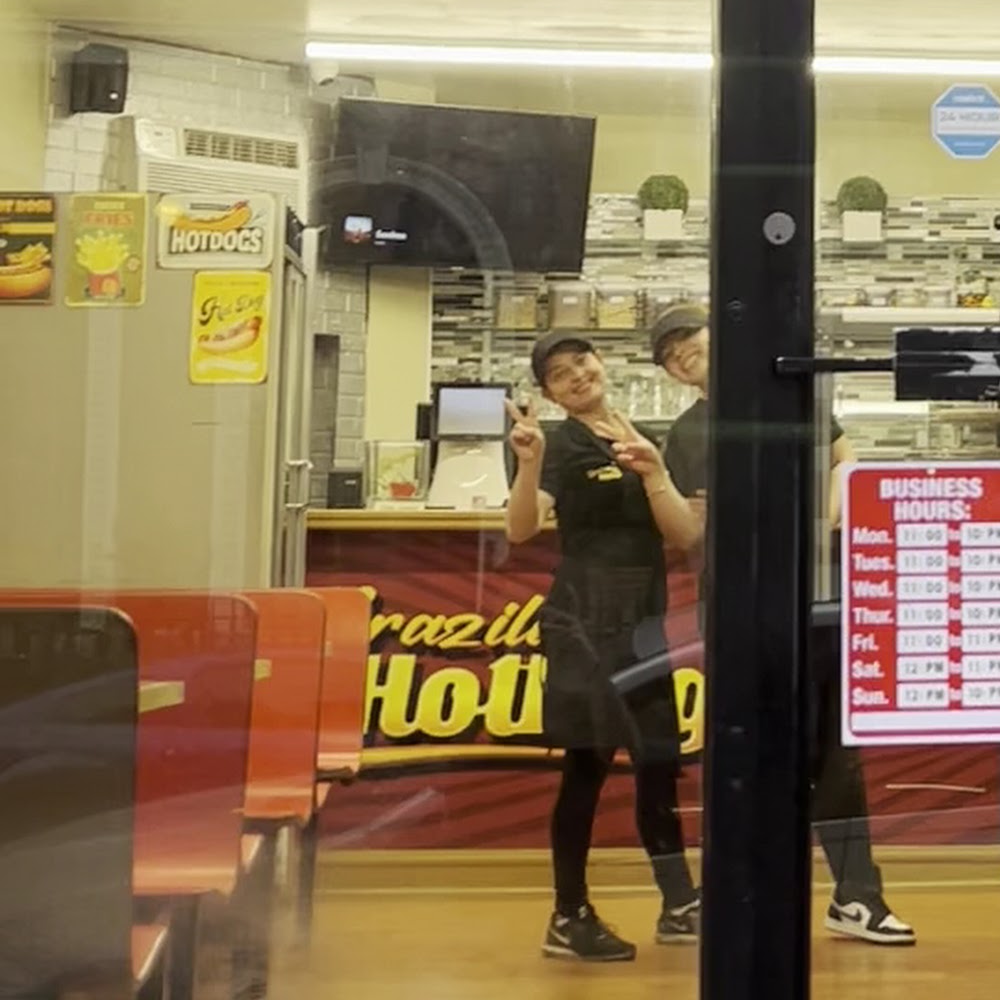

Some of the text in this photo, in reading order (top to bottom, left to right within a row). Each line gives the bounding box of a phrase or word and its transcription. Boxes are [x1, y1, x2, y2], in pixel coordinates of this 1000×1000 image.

[170, 227, 262, 254] HOTDOGS
[879, 477, 984, 500] BUSINESS
[893, 499, 972, 522] HOURS:
[852, 526, 893, 545] Mon.
[851, 552, 894, 572] Tues.
[852, 579, 894, 598] Wed.
[852, 633, 879, 652] Fri.
[852, 660, 885, 679] Sat.
[852, 687, 889, 706] Sun.
